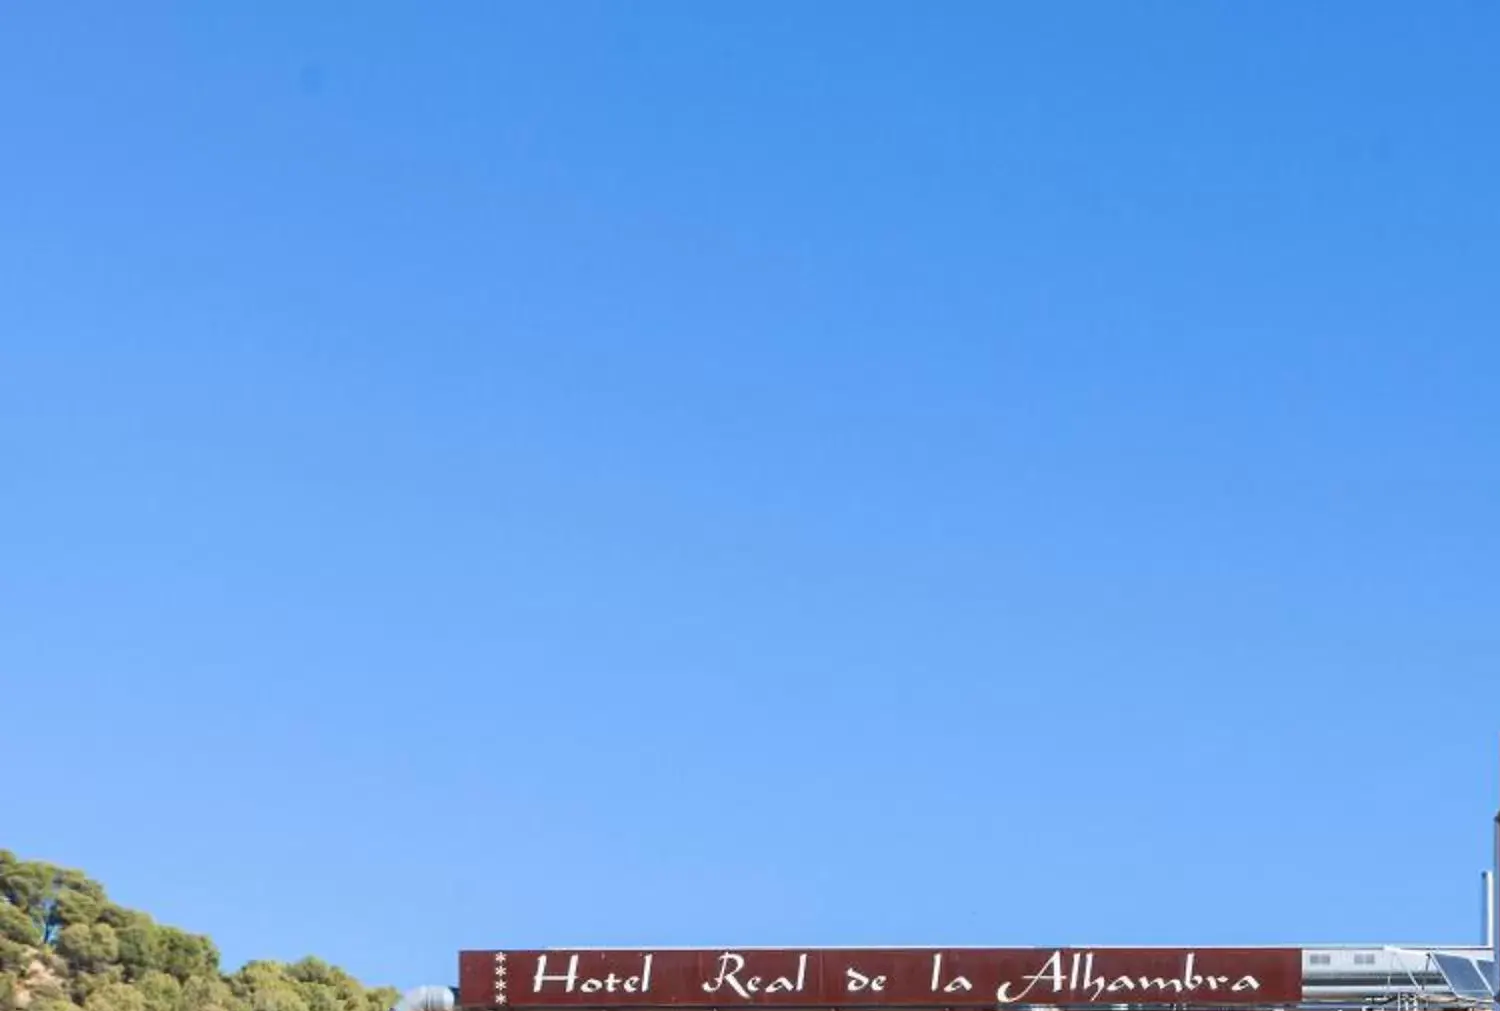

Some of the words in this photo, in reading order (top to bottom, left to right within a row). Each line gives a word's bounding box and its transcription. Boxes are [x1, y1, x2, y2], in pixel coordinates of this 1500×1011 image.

[533, 953, 652, 993] Hotel
[702, 952, 807, 999] Real
[846, 967, 887, 992] de
[930, 953, 973, 992] la
[997, 950, 1260, 1003] Alhambra
